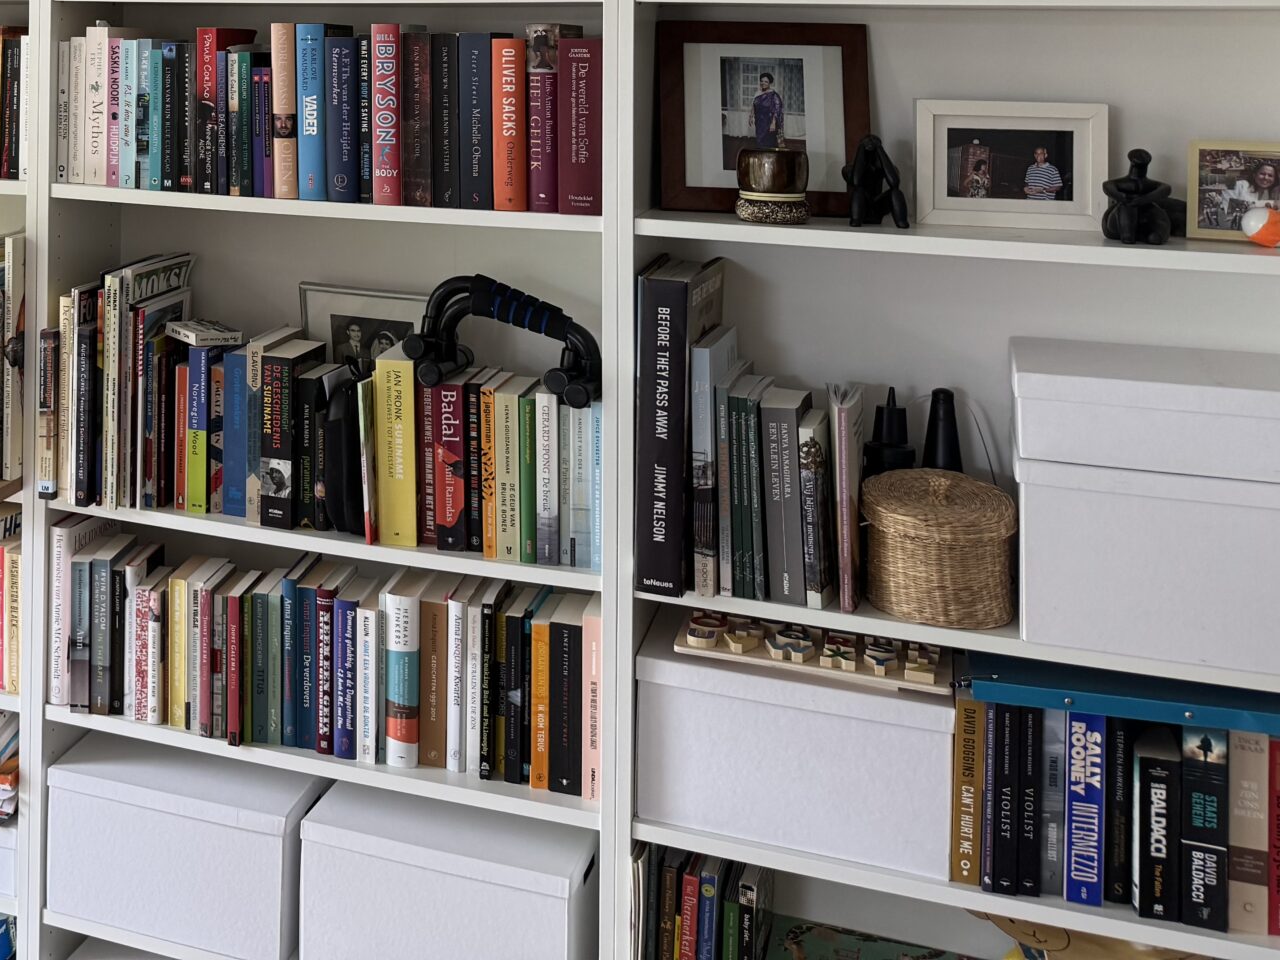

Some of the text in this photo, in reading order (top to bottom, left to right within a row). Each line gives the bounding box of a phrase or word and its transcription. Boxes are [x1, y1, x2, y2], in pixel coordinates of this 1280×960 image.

[110, 45, 119, 107] SASKIA NOORT
[203, 34, 212, 98] Paulo Coelho
[332, 48, 340, 105] Stemvorken
[305, 95, 317, 135] VADER
[342, 103, 350, 120] der
[376, 44, 397, 144] BRYSON
[502, 48, 516, 136] OLIVER SACKS
[578, 63, 588, 164] De wereld van Sofie
[89, 100, 103, 155] Mythos
[219, 114, 225, 122] DE
[340, 122, 351, 161] Heijden
[472, 109, 481, 177] Michelle Obama
[530, 76, 541, 170] HET GELUK
[110, 126, 118, 164] HUIDPIJN
[506, 141, 515, 186] Onderweg
[376, 169, 397, 177] BODY
[273, 365, 280, 377] DE
[656, 307, 670, 439] BEFORE THEY PASS AWAY
[190, 383, 199, 428] Norwegian
[393, 370, 403, 480] JAN PRONK SURINAME
[441, 390, 459, 441] Badal
[484, 402, 492, 443] jaguarman
[542, 405, 550, 473] GERARD SPONG
[301, 456, 311, 503] paramaribo
[509, 483, 515, 492] DE
[542, 477, 550, 488] De
[653, 464, 666, 542] JIMMY NELSON
[643, 578, 673, 588] teNeues
[76, 629, 84, 649] Ann
[284, 621, 292, 650] Enquist
[303, 655, 310, 666] De
[256, 670, 264, 695] TITUS
[481, 719, 489, 756] Philosophy
[962, 708, 976, 778] DAVID GOGGINS
[1070, 721, 1085, 796] ROONEY
[1086, 732, 1101, 788] SALLY
[960, 785, 974, 855] CAN'T HURT ME
[1001, 787, 1010, 838] VIOLIST
[1025, 788, 1034, 839] VIOLIST
[1151, 789, 1166, 858] BALDACCI
[1192, 792, 1203, 827] GEHEIM
[1206, 795, 1216, 829] STAATS
[1071, 802, 1099, 883] INTERMEZZO
[1191, 851, 1203, 903] BALDACCI
[1205, 853, 1216, 885] DAVID
